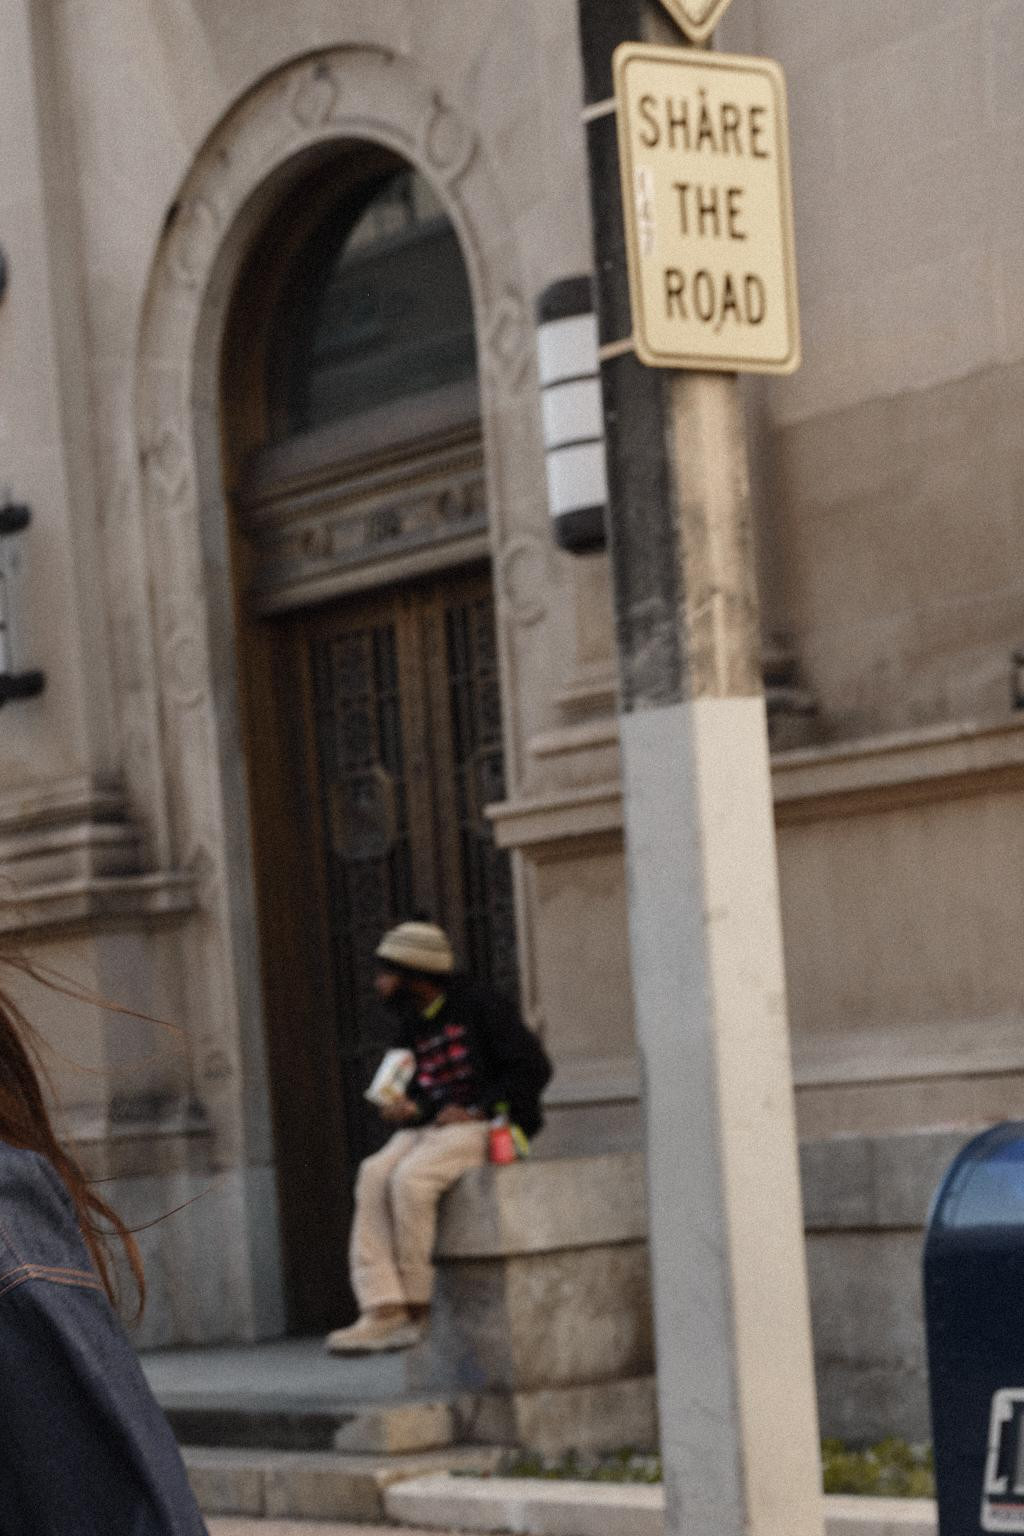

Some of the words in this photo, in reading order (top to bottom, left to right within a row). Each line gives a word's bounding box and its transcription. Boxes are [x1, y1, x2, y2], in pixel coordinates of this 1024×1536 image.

[639, 95, 770, 159] SHARE
[673, 181, 747, 242] THE
[663, 267, 767, 326] ROAD
